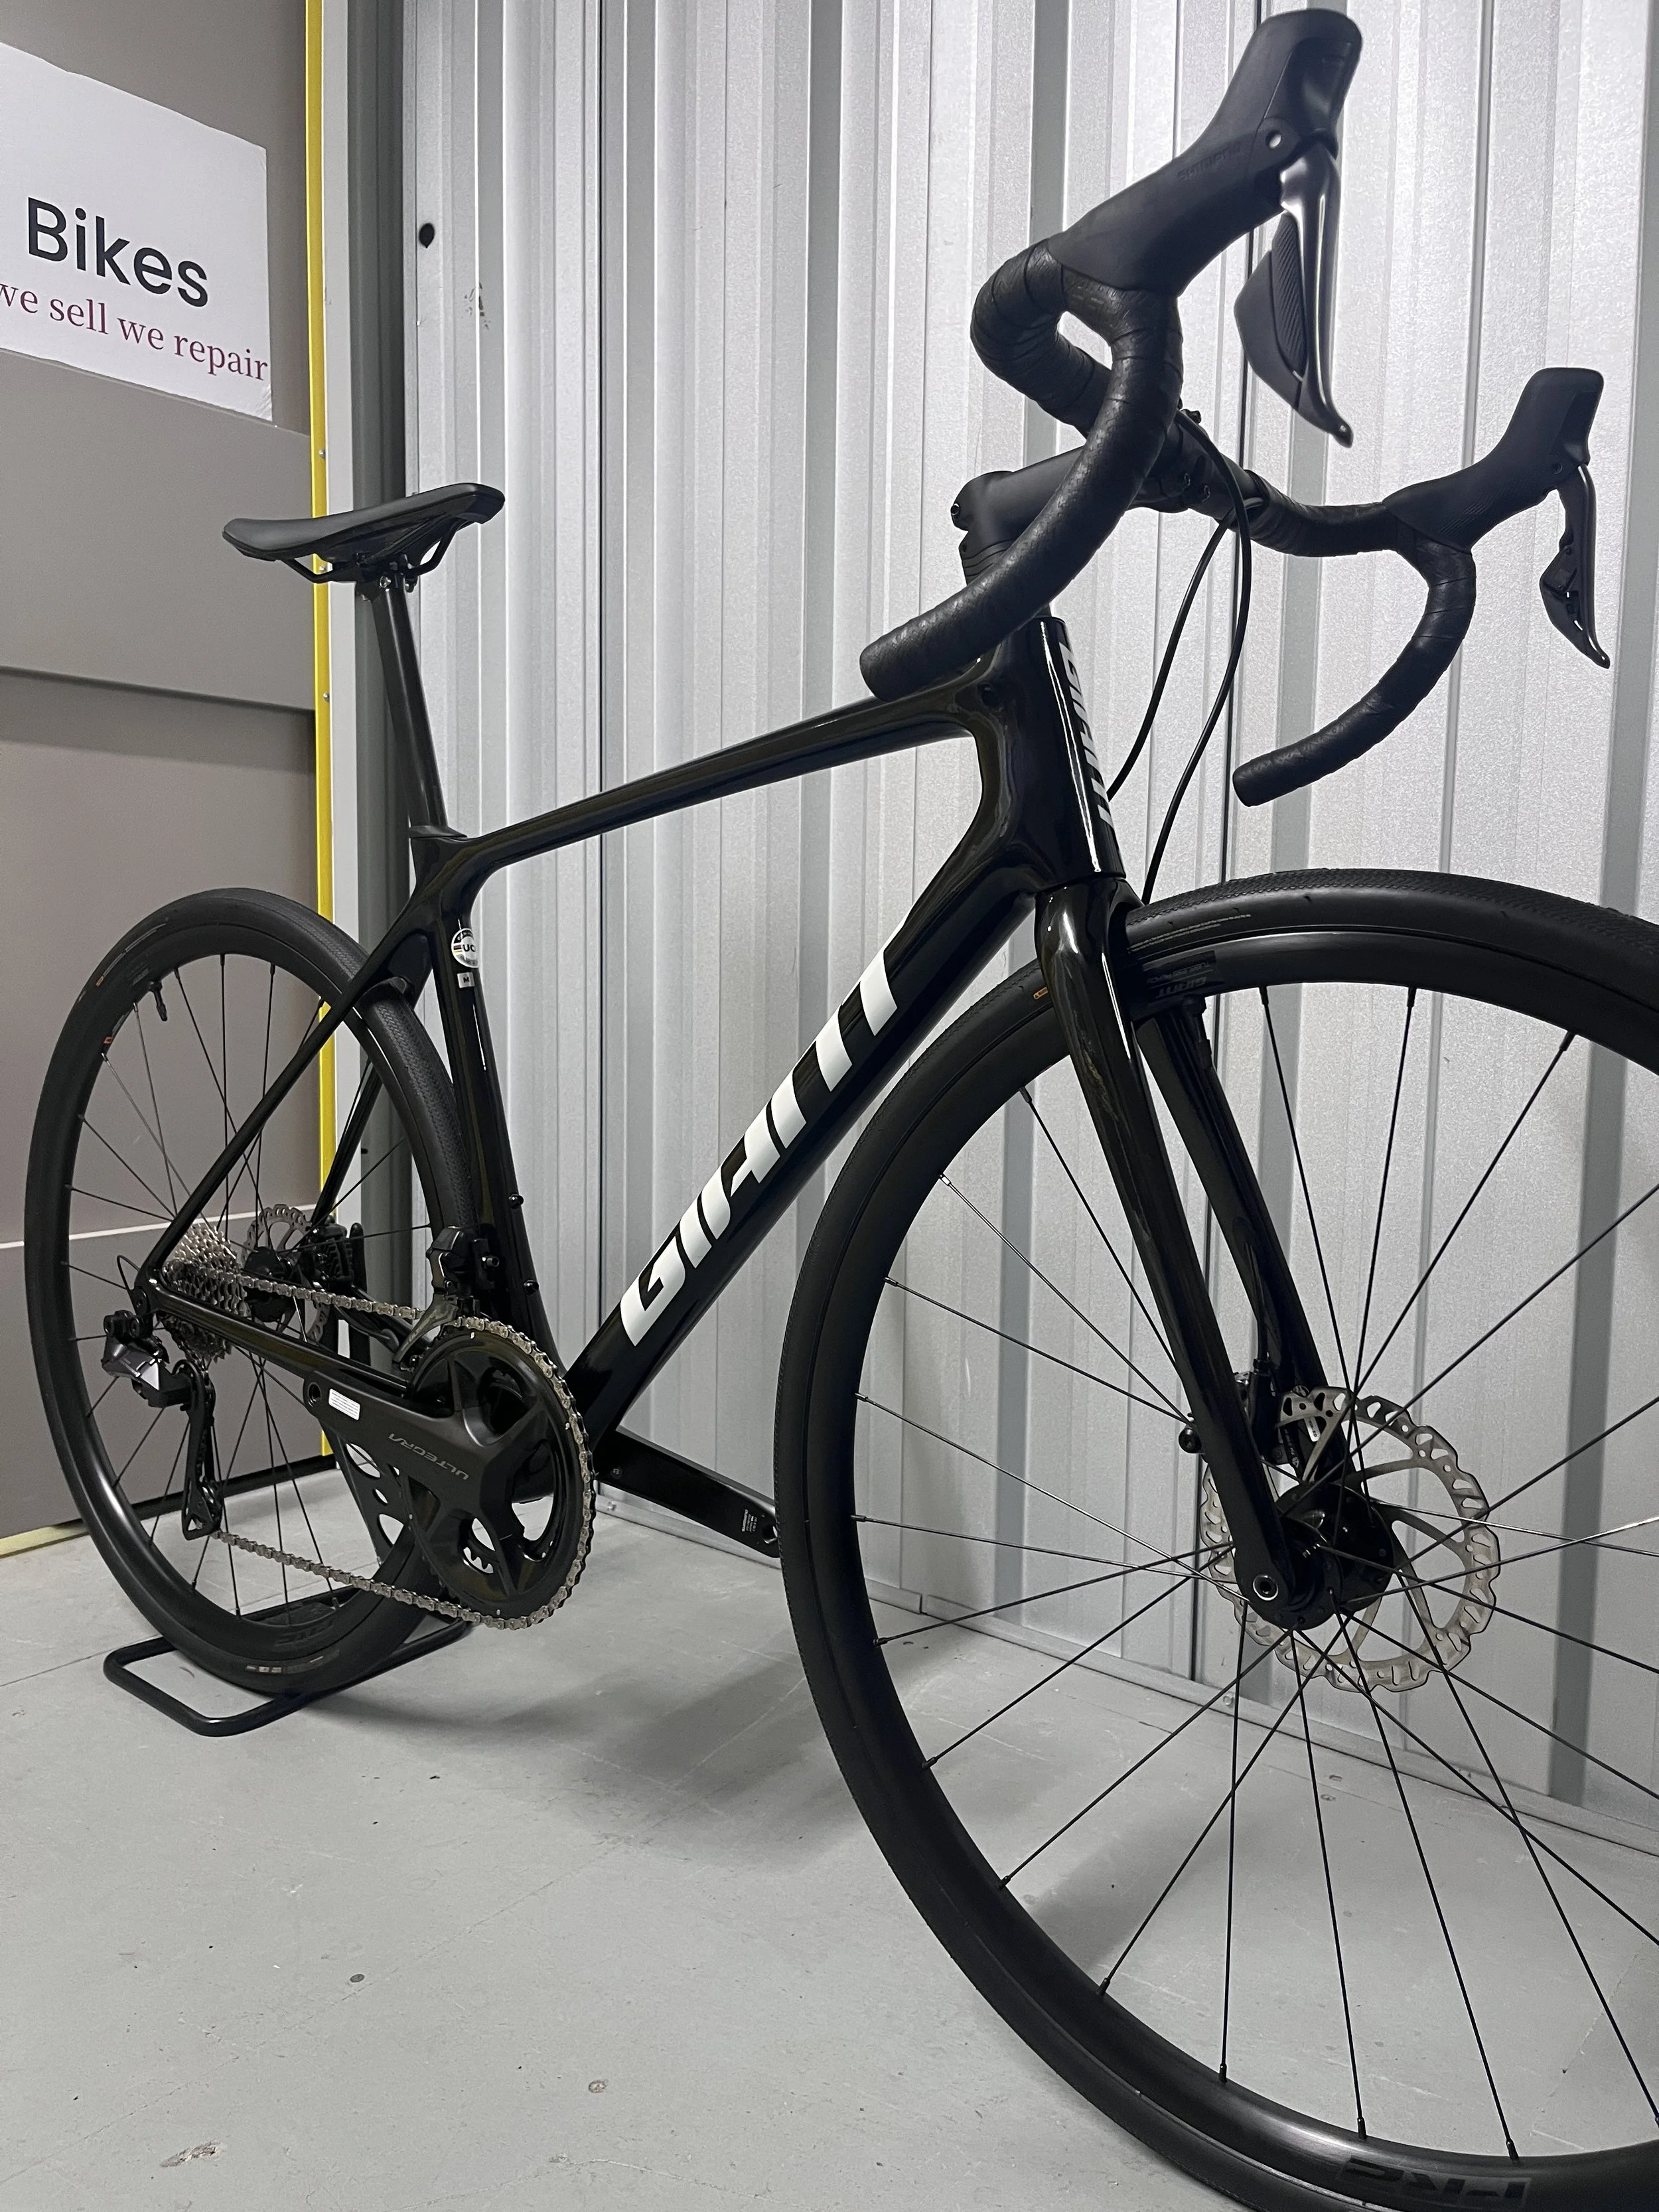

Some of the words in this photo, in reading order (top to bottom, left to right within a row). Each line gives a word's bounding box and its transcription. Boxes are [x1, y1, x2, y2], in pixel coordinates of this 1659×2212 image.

[28, 196, 208, 307] Bikes
[0, 283, 38, 314] we
[50, 297, 109, 334] sell
[117, 317, 165, 350] we
[174, 334, 268, 381] repair
[620, 916, 901, 1347] GIANT
[388, 1433, 470, 1481] ULTEGRA
